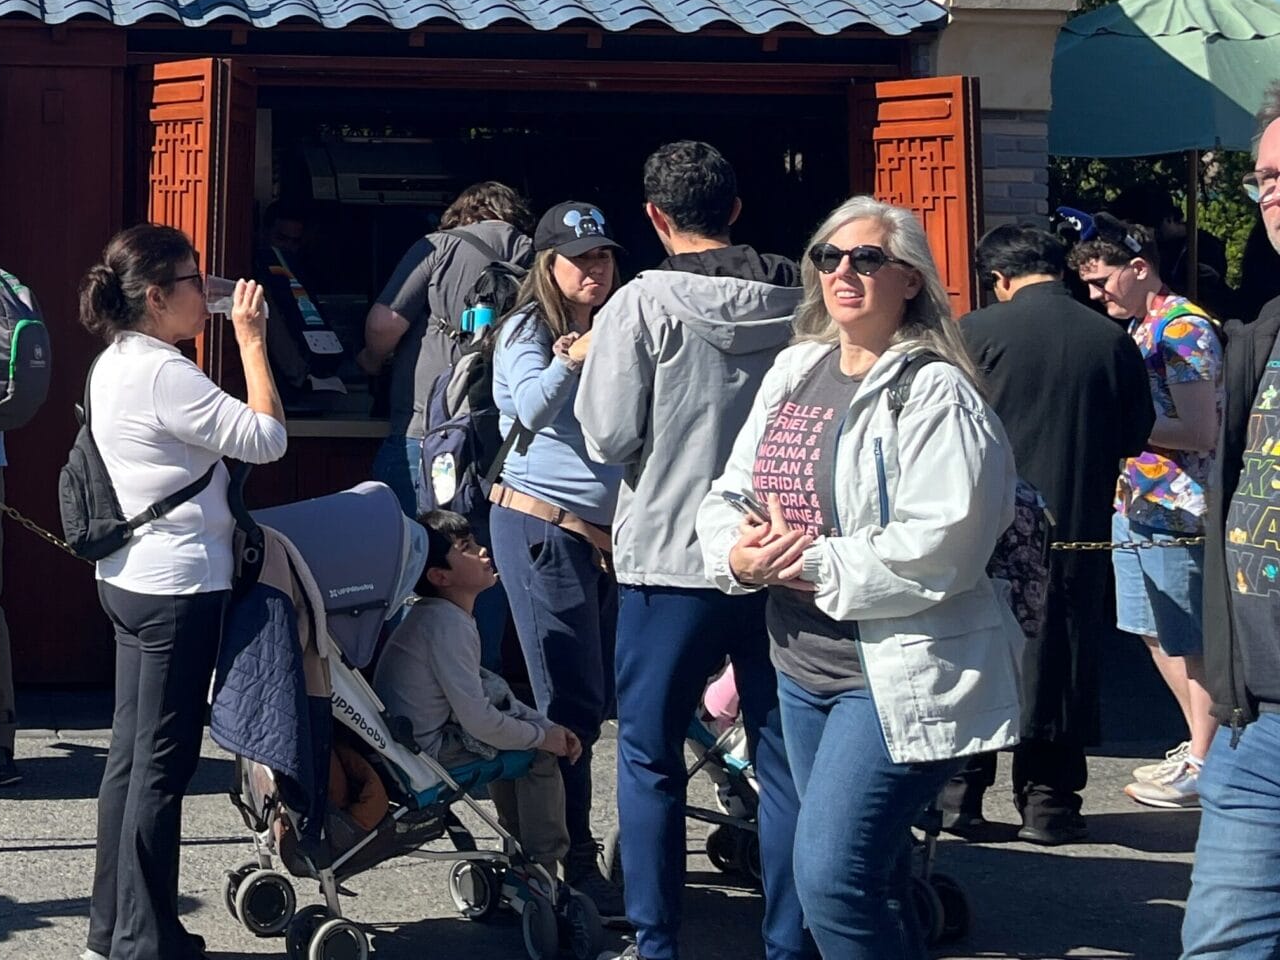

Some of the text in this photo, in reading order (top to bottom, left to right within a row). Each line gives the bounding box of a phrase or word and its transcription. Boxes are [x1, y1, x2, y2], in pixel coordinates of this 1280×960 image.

[782, 401, 834, 420] ELLE &
[773, 415, 824, 433] RIEL &
[805, 434, 817, 446] &
[810, 448, 821, 461] &
[754, 459, 814, 476] MULAN &
[752, 475, 815, 492] MERIDA &
[755, 491, 821, 508] AUORA &
[815, 510, 824, 525] &
[331, 692, 387, 749] UPPAbaby
